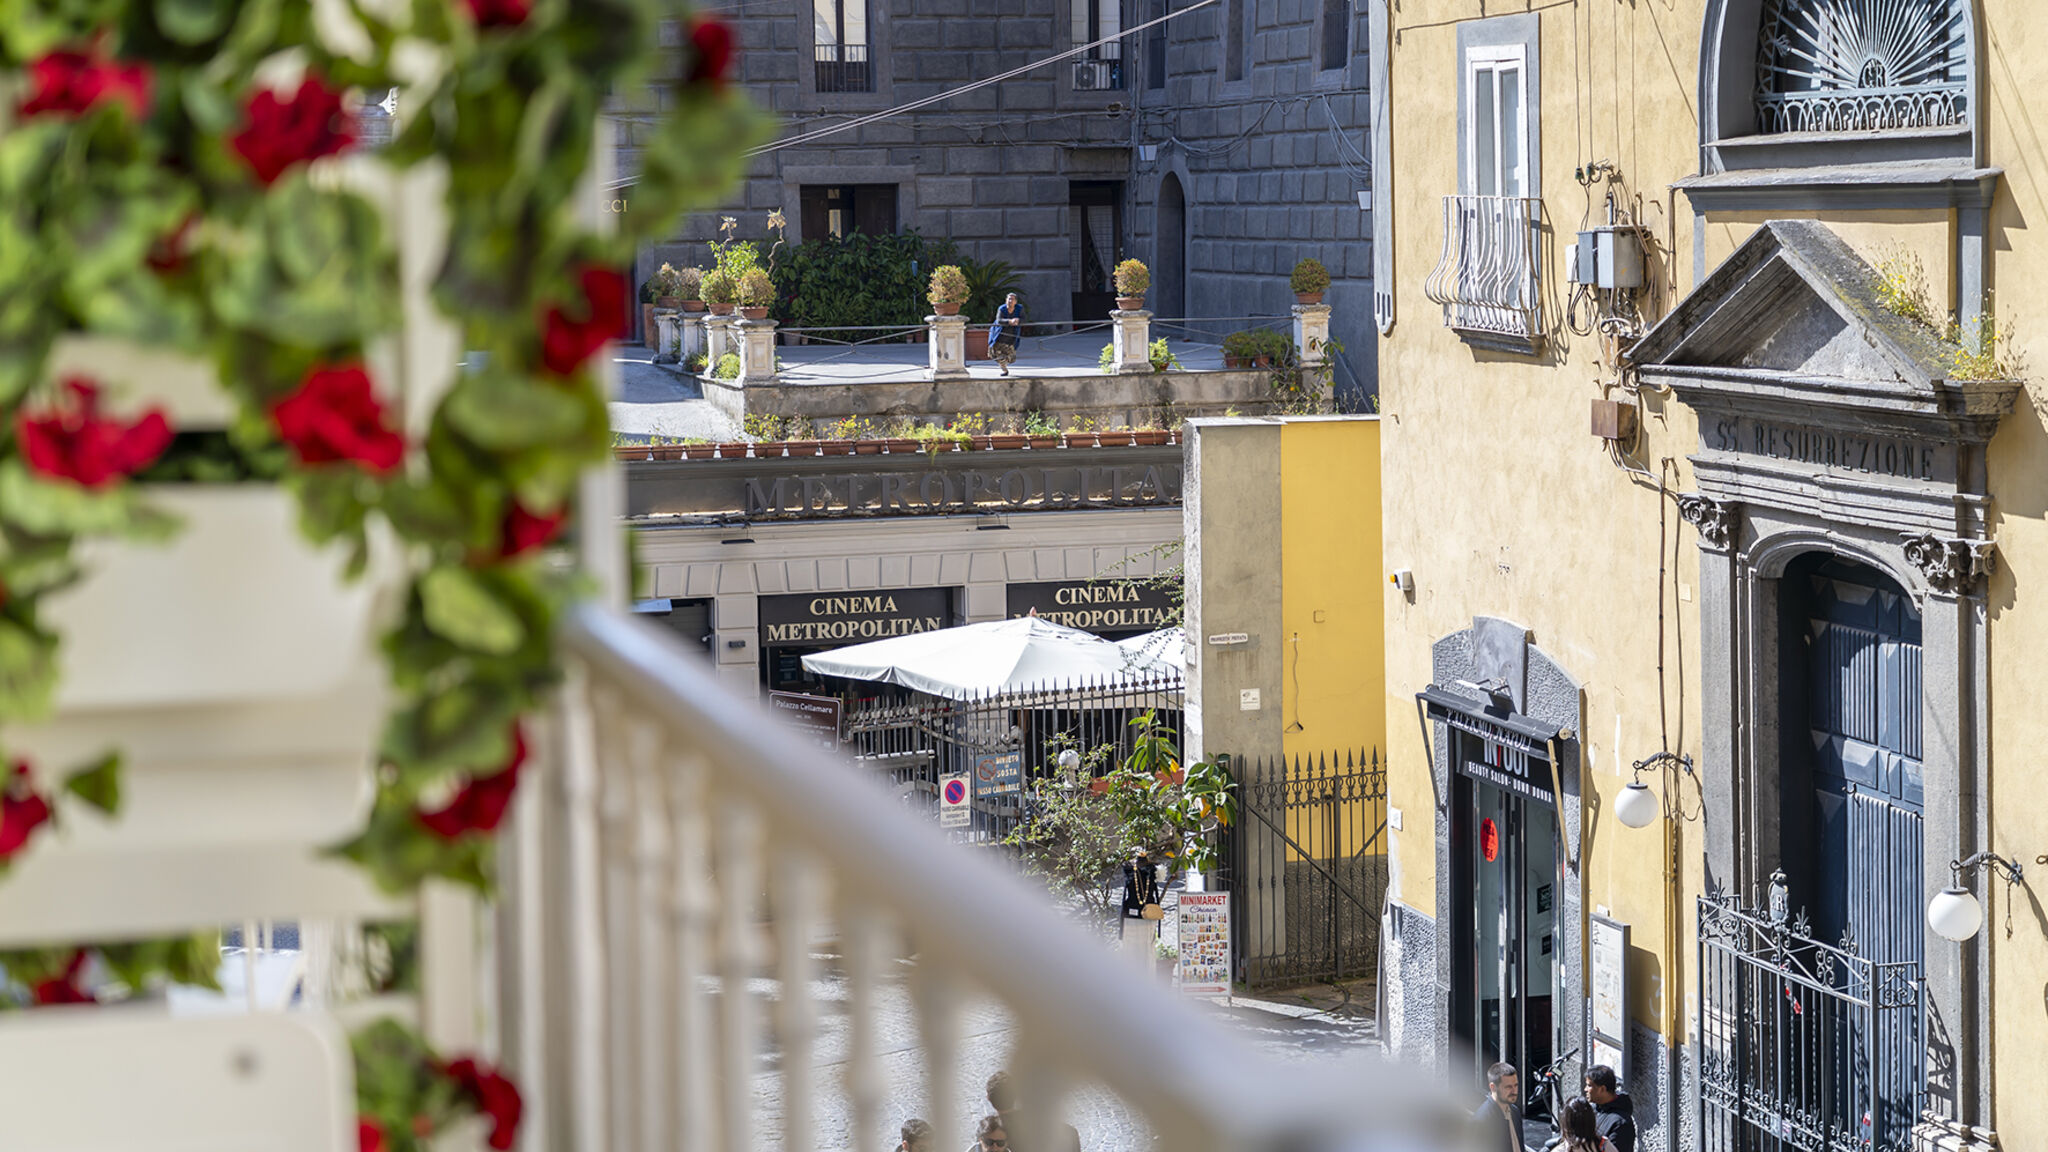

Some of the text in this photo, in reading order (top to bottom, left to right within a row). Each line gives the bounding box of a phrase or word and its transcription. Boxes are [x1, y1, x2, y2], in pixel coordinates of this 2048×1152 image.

[1754, 423, 1936, 481] RESURREZIONE
[744, 463, 1183, 516] METROPOLITA
[810, 595, 898, 616] CINEMA
[1055, 585, 1141, 606] CINEMA
[767, 616, 941, 643] METROPOLITAN
[776, 699, 800, 710] Palazzo
[1180, 895, 1227, 906] MINIMARKET
